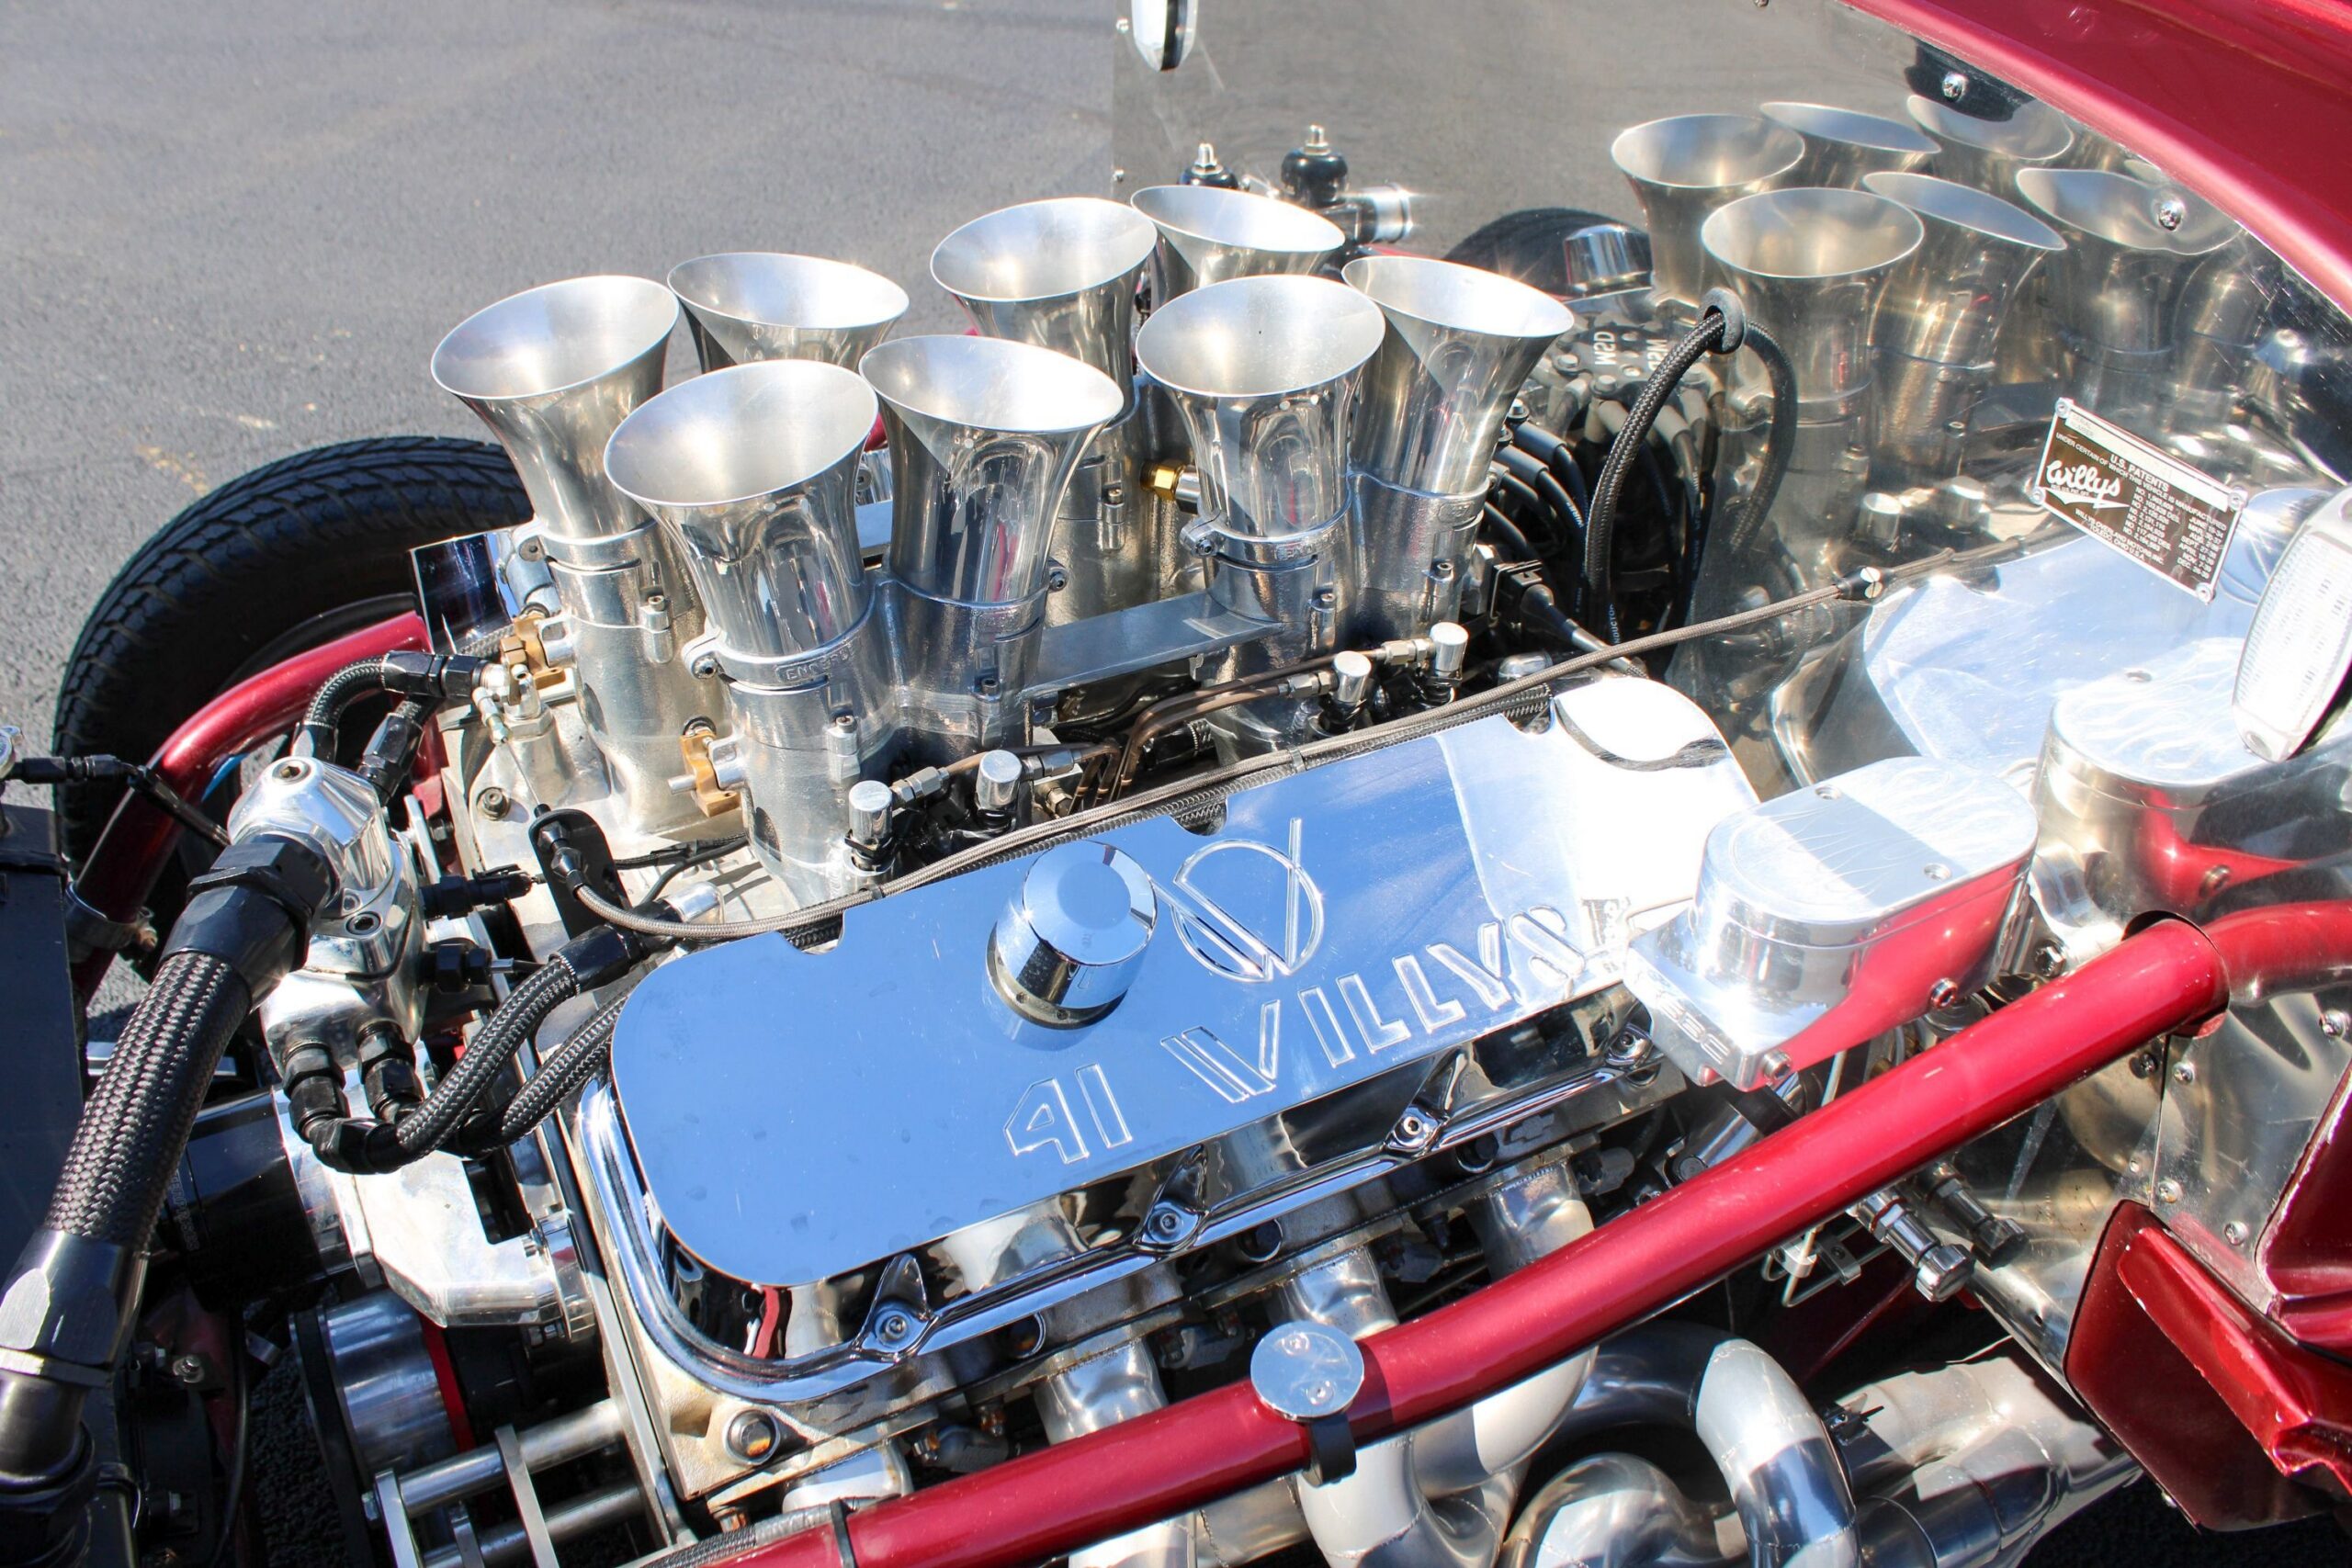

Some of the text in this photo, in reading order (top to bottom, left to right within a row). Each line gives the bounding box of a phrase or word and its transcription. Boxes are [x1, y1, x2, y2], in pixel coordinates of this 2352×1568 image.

[2056, 433, 2075, 446] UNDER
[2075, 444, 2098, 461] CERTAIN
[2099, 457, 2108, 466] OF
[2109, 463, 2127, 477] WHICH
[2129, 474, 2141, 485] THIS
[2143, 482, 2167, 499] VEHICLE
[2176, 500, 2226, 530] MANUFACTURED
[2109, 454, 2168, 491] U.S. PATENTS
[2189, 515, 2207, 529] JUNE
[2114, 538, 2128, 550] OHIO
[2179, 542, 2197, 557] APRIL
[1003, 904, 1587, 1165] 41 WILLYS
